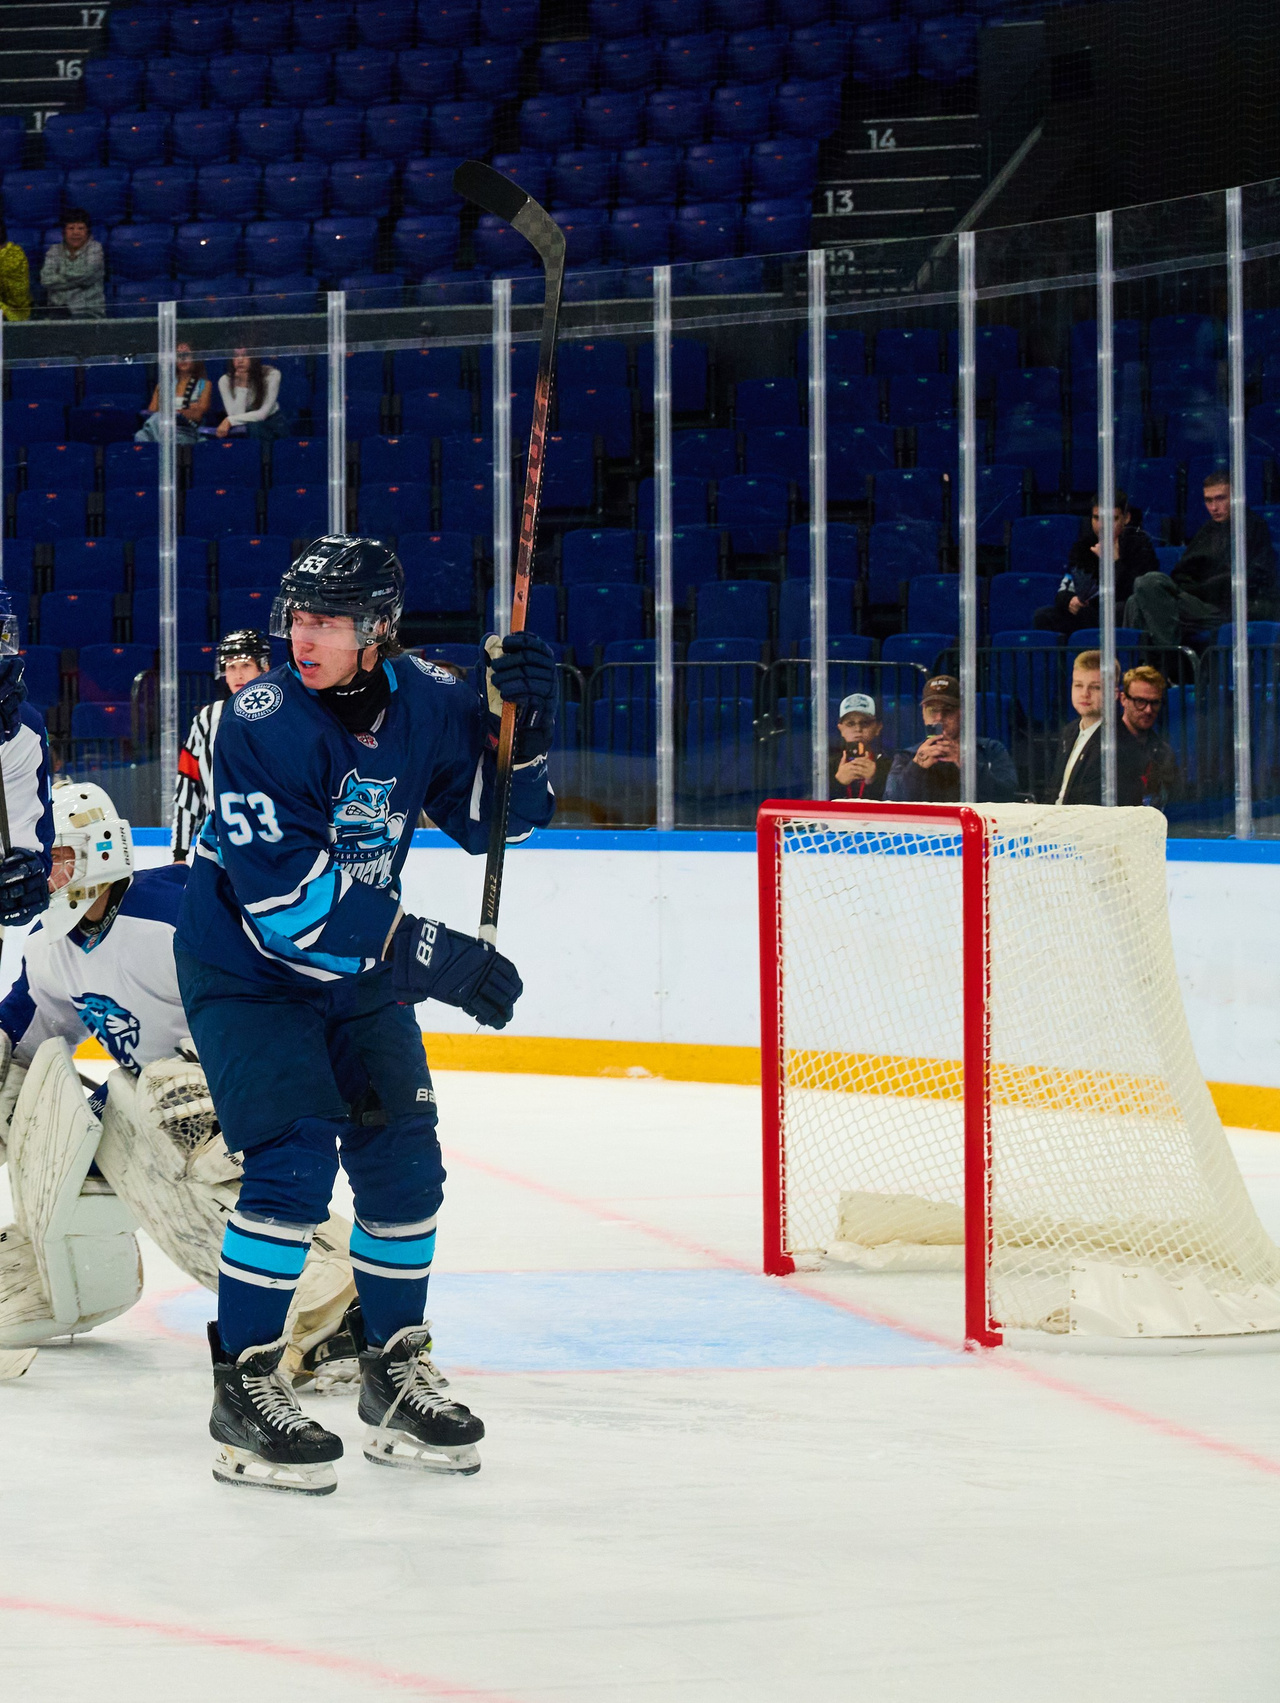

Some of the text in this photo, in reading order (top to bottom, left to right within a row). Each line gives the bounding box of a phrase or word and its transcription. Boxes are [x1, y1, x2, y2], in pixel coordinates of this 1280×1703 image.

[81, 9, 106, 28] 17
[56, 59, 82, 79] 16
[868, 128, 896, 149] 14
[824, 189, 854, 215] 13
[298, 555, 329, 574] 53
[220, 791, 284, 846] 53
